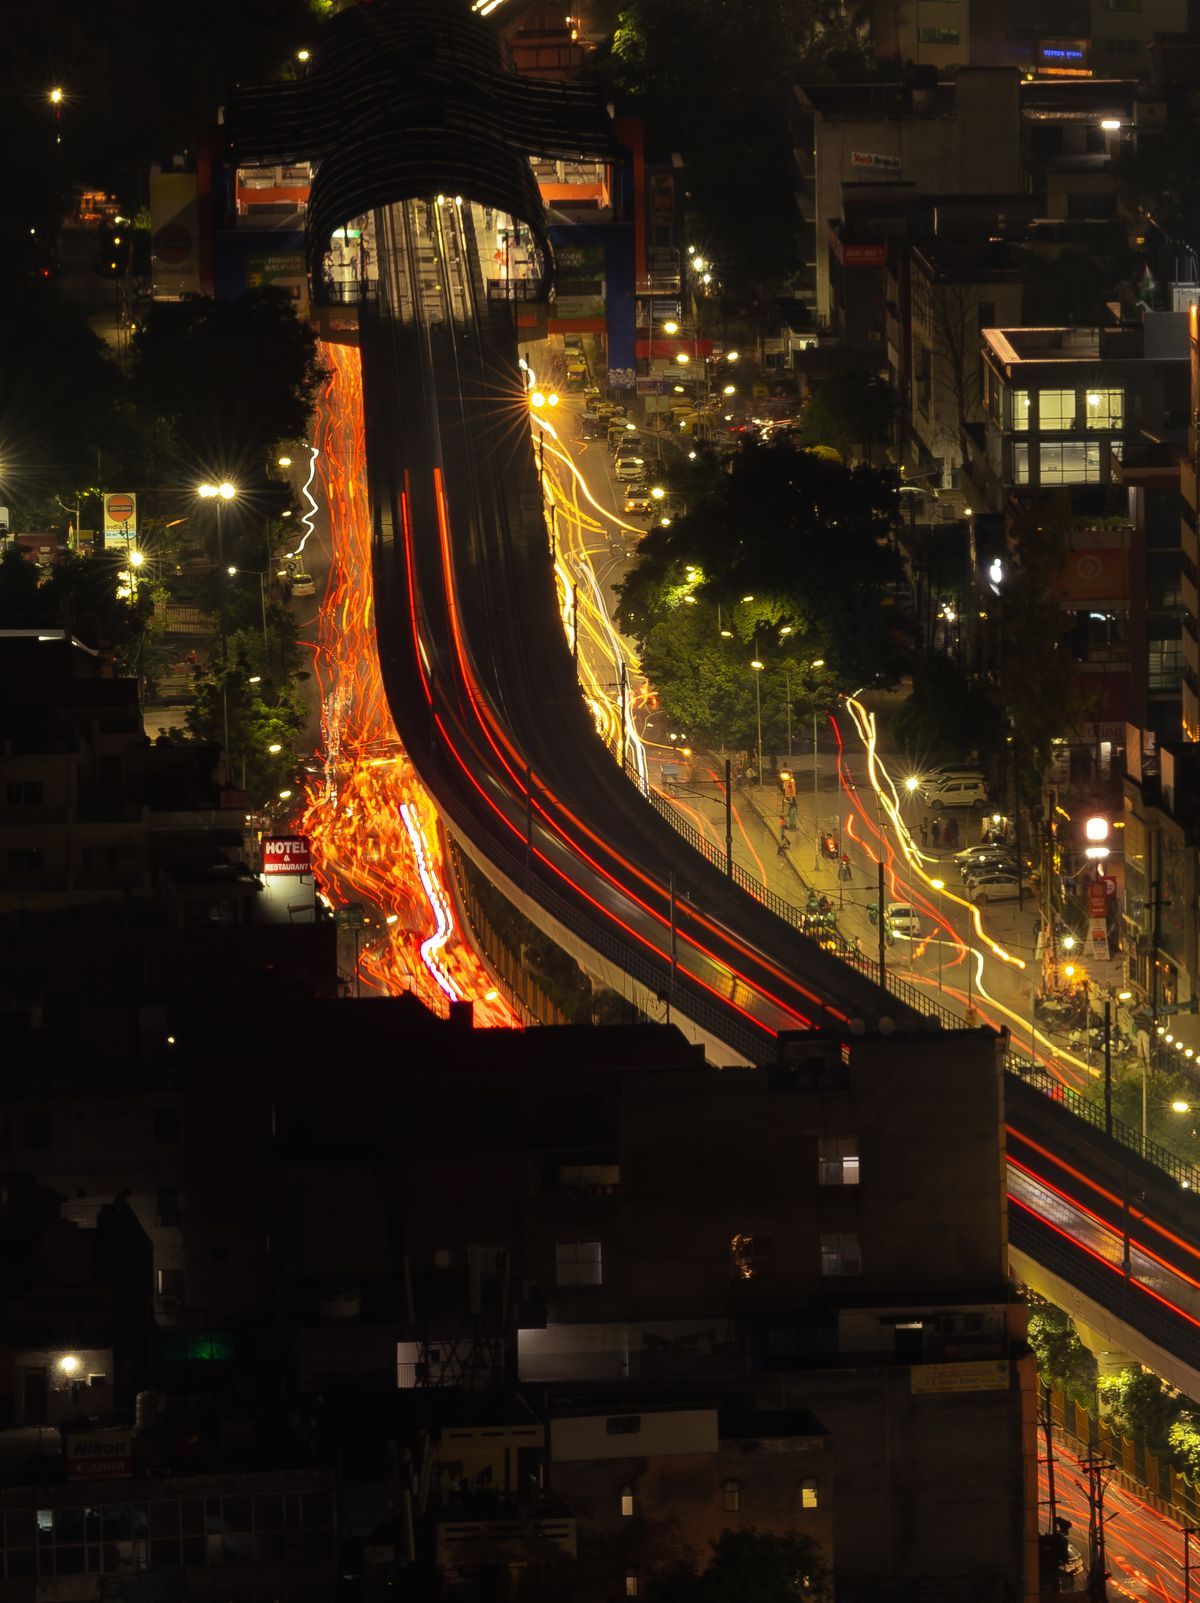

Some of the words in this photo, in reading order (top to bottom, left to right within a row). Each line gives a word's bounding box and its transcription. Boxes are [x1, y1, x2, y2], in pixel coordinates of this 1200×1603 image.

[265, 841, 308, 854] HOTEL
[283, 854, 291, 862] &
[264, 863, 308, 871] RESTAURANT
[74, 1440, 127, 1456] Nikon
[76, 1460, 127, 1473] Canon
